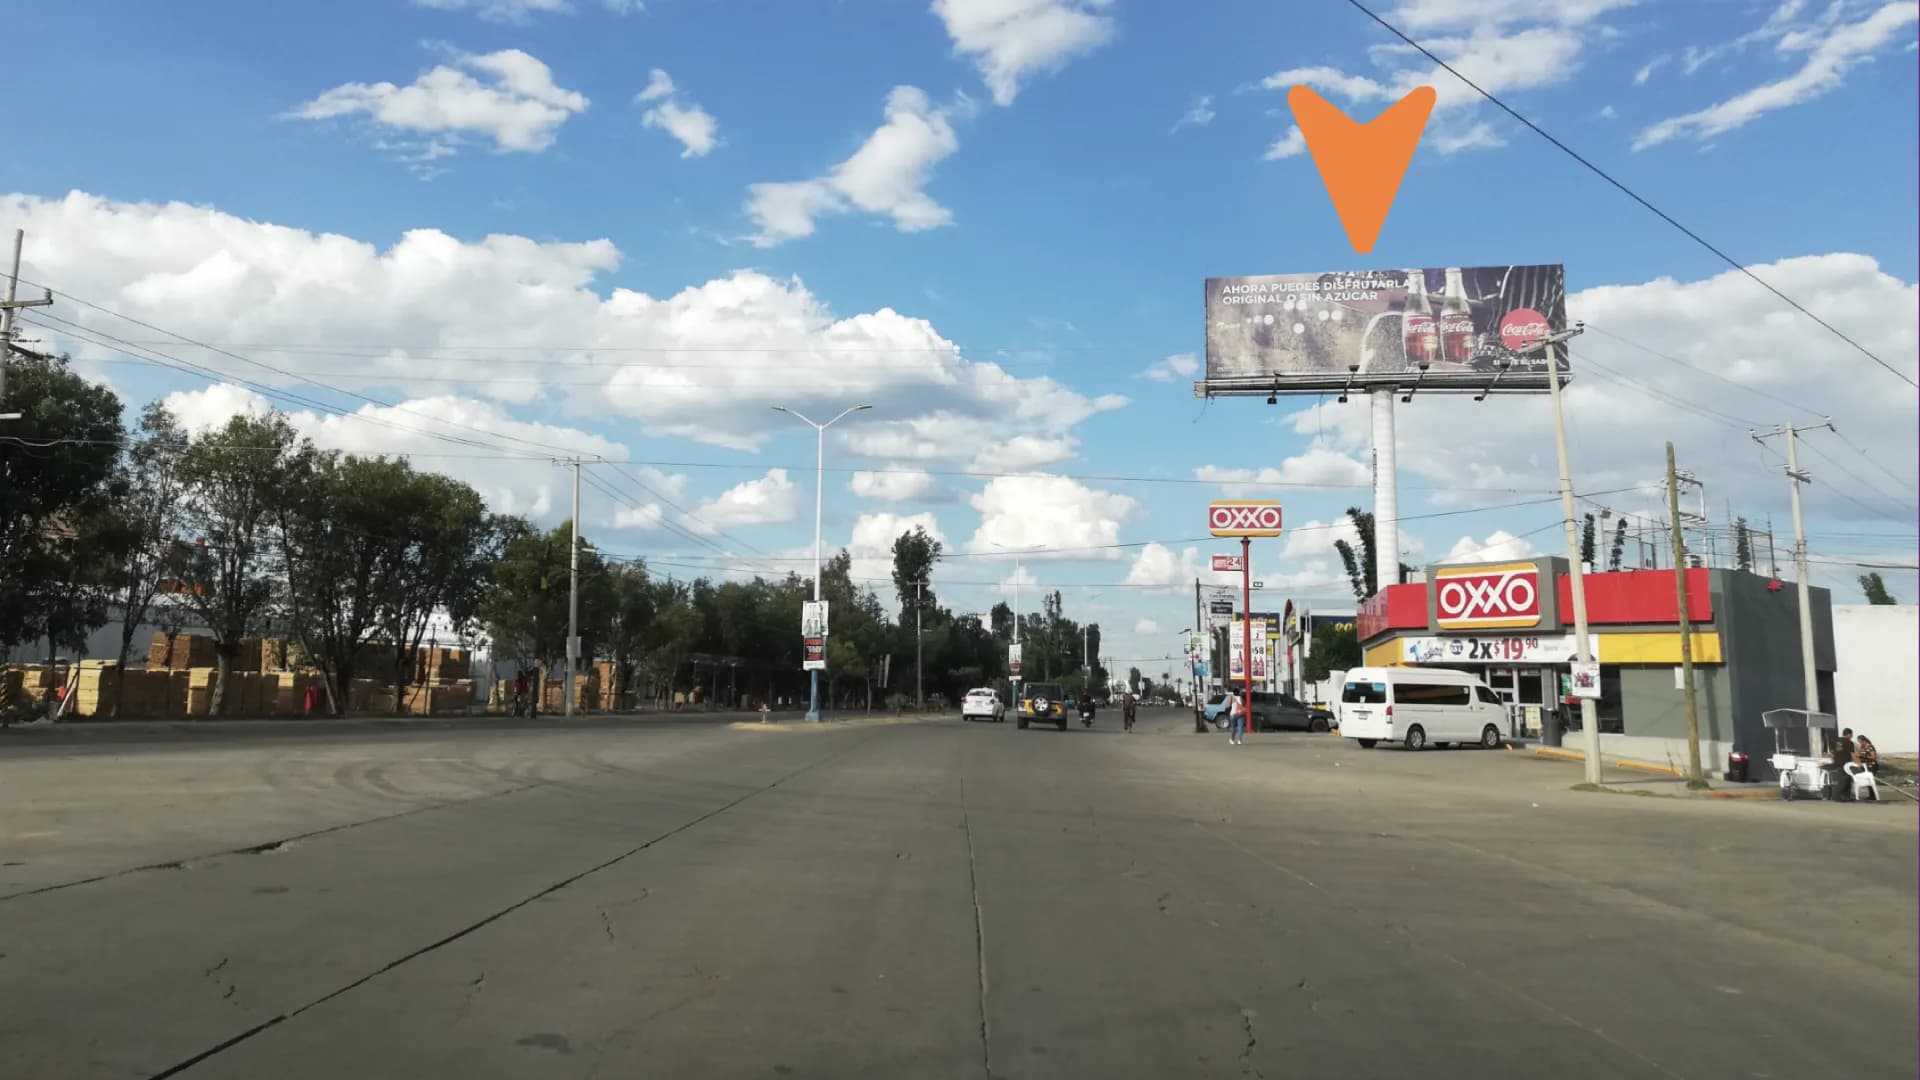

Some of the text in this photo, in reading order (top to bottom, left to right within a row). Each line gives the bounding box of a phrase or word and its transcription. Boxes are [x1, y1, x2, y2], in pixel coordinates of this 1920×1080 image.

[1222, 279, 1409, 295] AHORA PUEDES DISFRUTARLA
[1223, 294, 1281, 305] ORIGINAL
[1286, 294, 1296, 302] O
[1300, 291, 1321, 302] SIN
[1212, 506, 1280, 529] OXXO
[1440, 573, 1535, 620] OXXO
